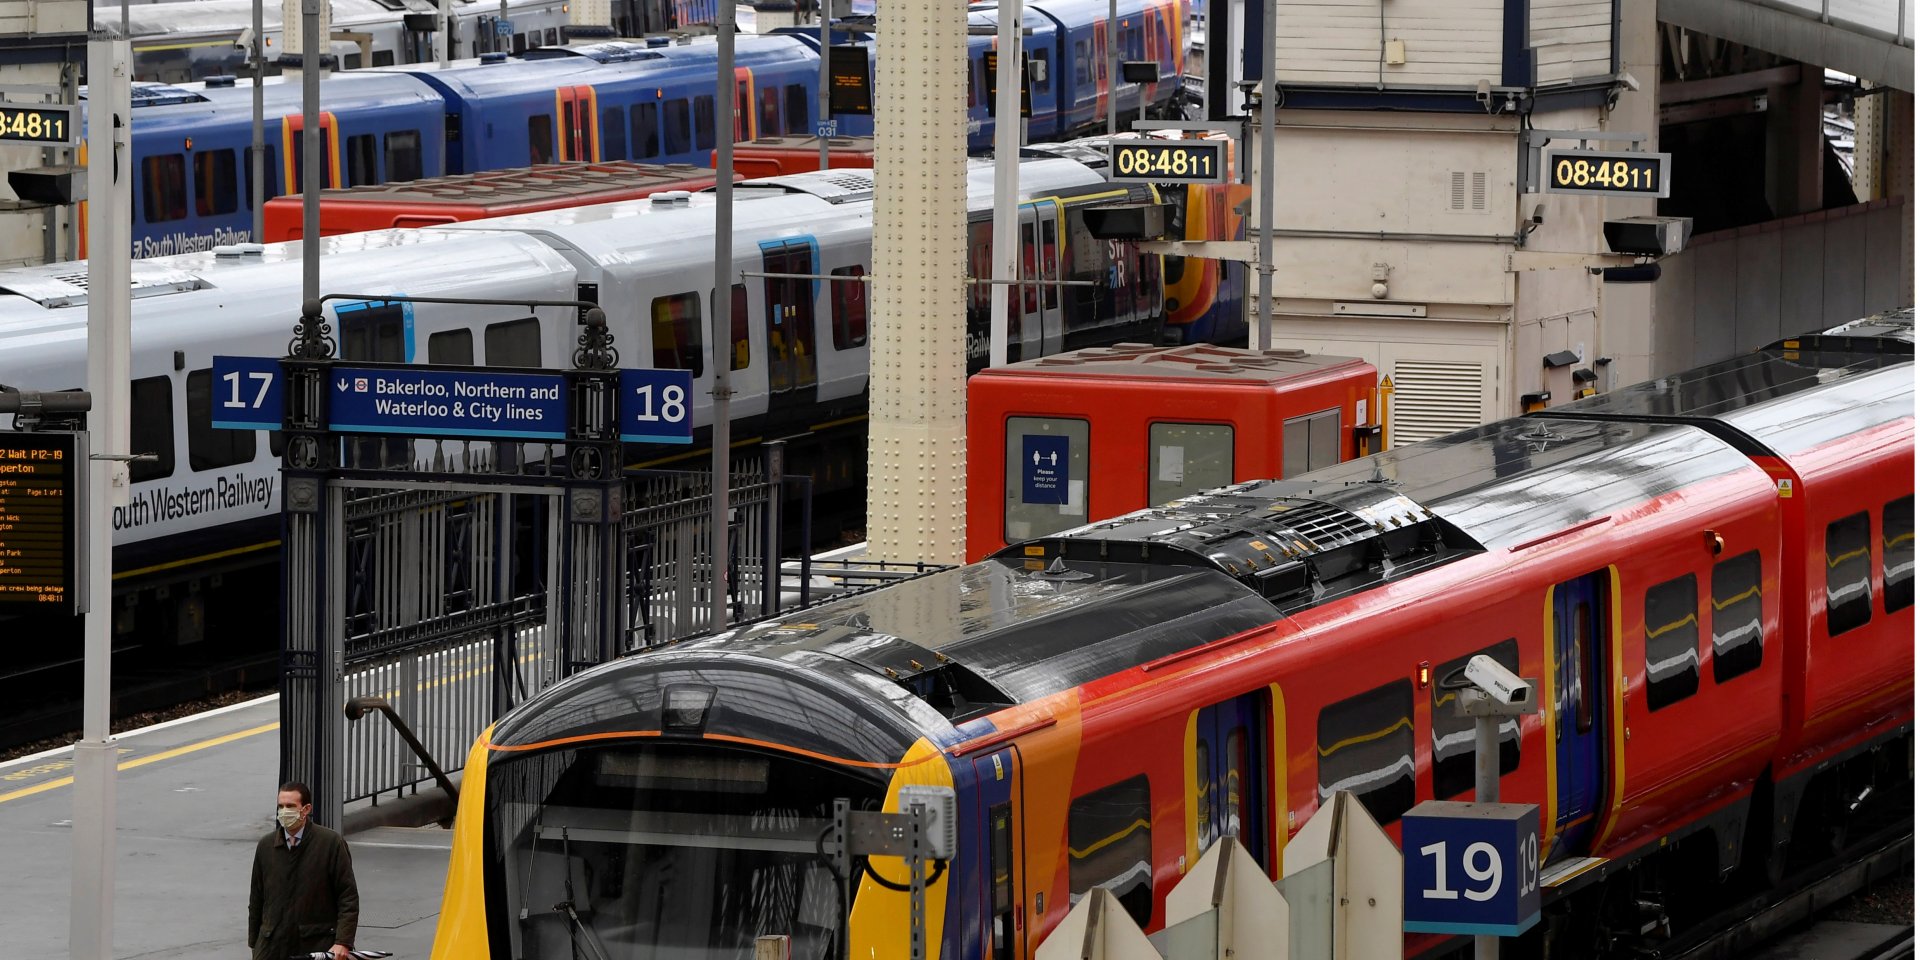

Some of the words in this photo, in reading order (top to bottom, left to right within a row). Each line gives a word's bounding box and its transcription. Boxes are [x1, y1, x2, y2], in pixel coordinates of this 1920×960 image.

[818, 126, 836, 137] 031
[144, 233, 174, 259] South
[173, 231, 214, 255] Western
[1108, 238, 1125, 260] SW
[967, 330, 991, 360] Railw
[223, 371, 274, 409] 17
[376, 378, 450, 398] Bakerloo,
[454, 381, 526, 400] Northern
[529, 384, 560, 400] and
[375, 399, 449, 417] Waterloo
[452, 401, 465, 418] &
[469, 402, 502, 422] City
[506, 403, 543, 420] lines
[635, 384, 686, 423] 18
[8, 449, 27, 459] Wait
[0, 480, 17, 488] gston
[112, 492, 149, 531] outh
[150, 486, 215, 523] Western
[217, 472, 274, 510] Railway
[1420, 840, 1503, 902] 19
[1519, 831, 1538, 898] 19
